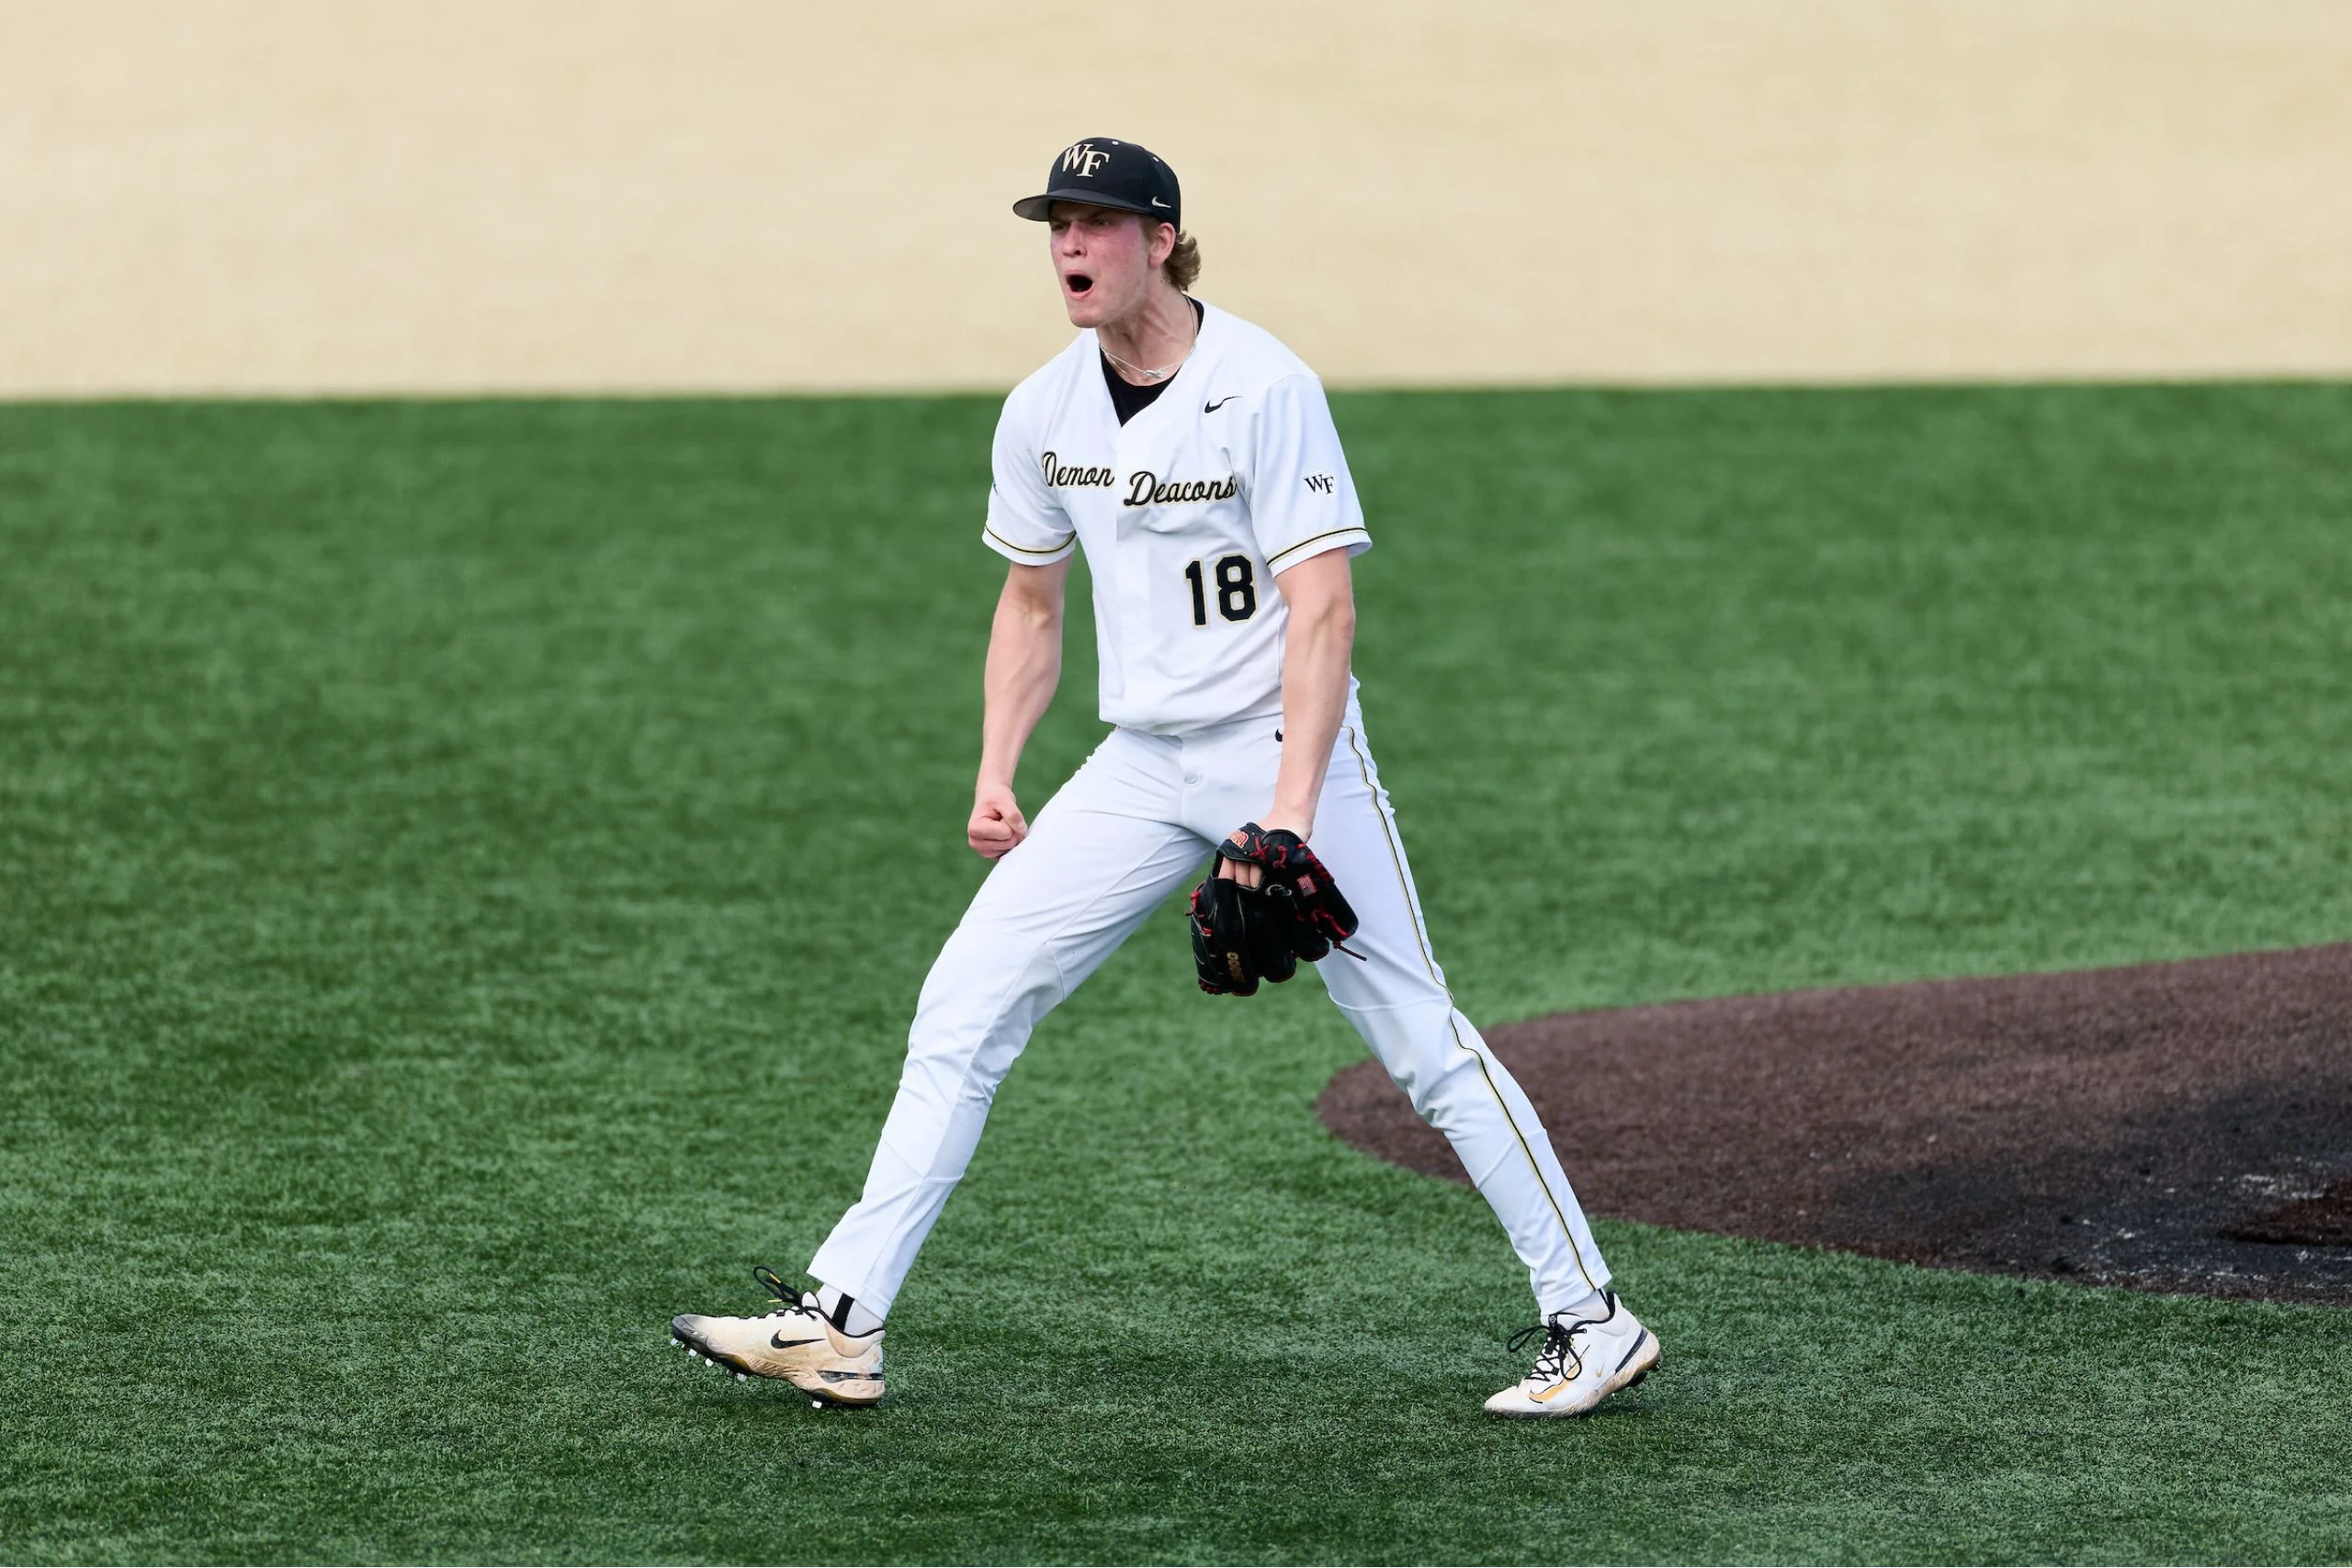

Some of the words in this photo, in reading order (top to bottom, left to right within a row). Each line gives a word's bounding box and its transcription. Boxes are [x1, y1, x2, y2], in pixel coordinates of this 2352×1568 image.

[1062, 143, 1111, 177] WF
[1042, 450, 1115, 488] Demon
[1123, 470, 1238, 506] Deacons
[1304, 473, 1335, 494] WF
[1184, 554, 1257, 626] 18
